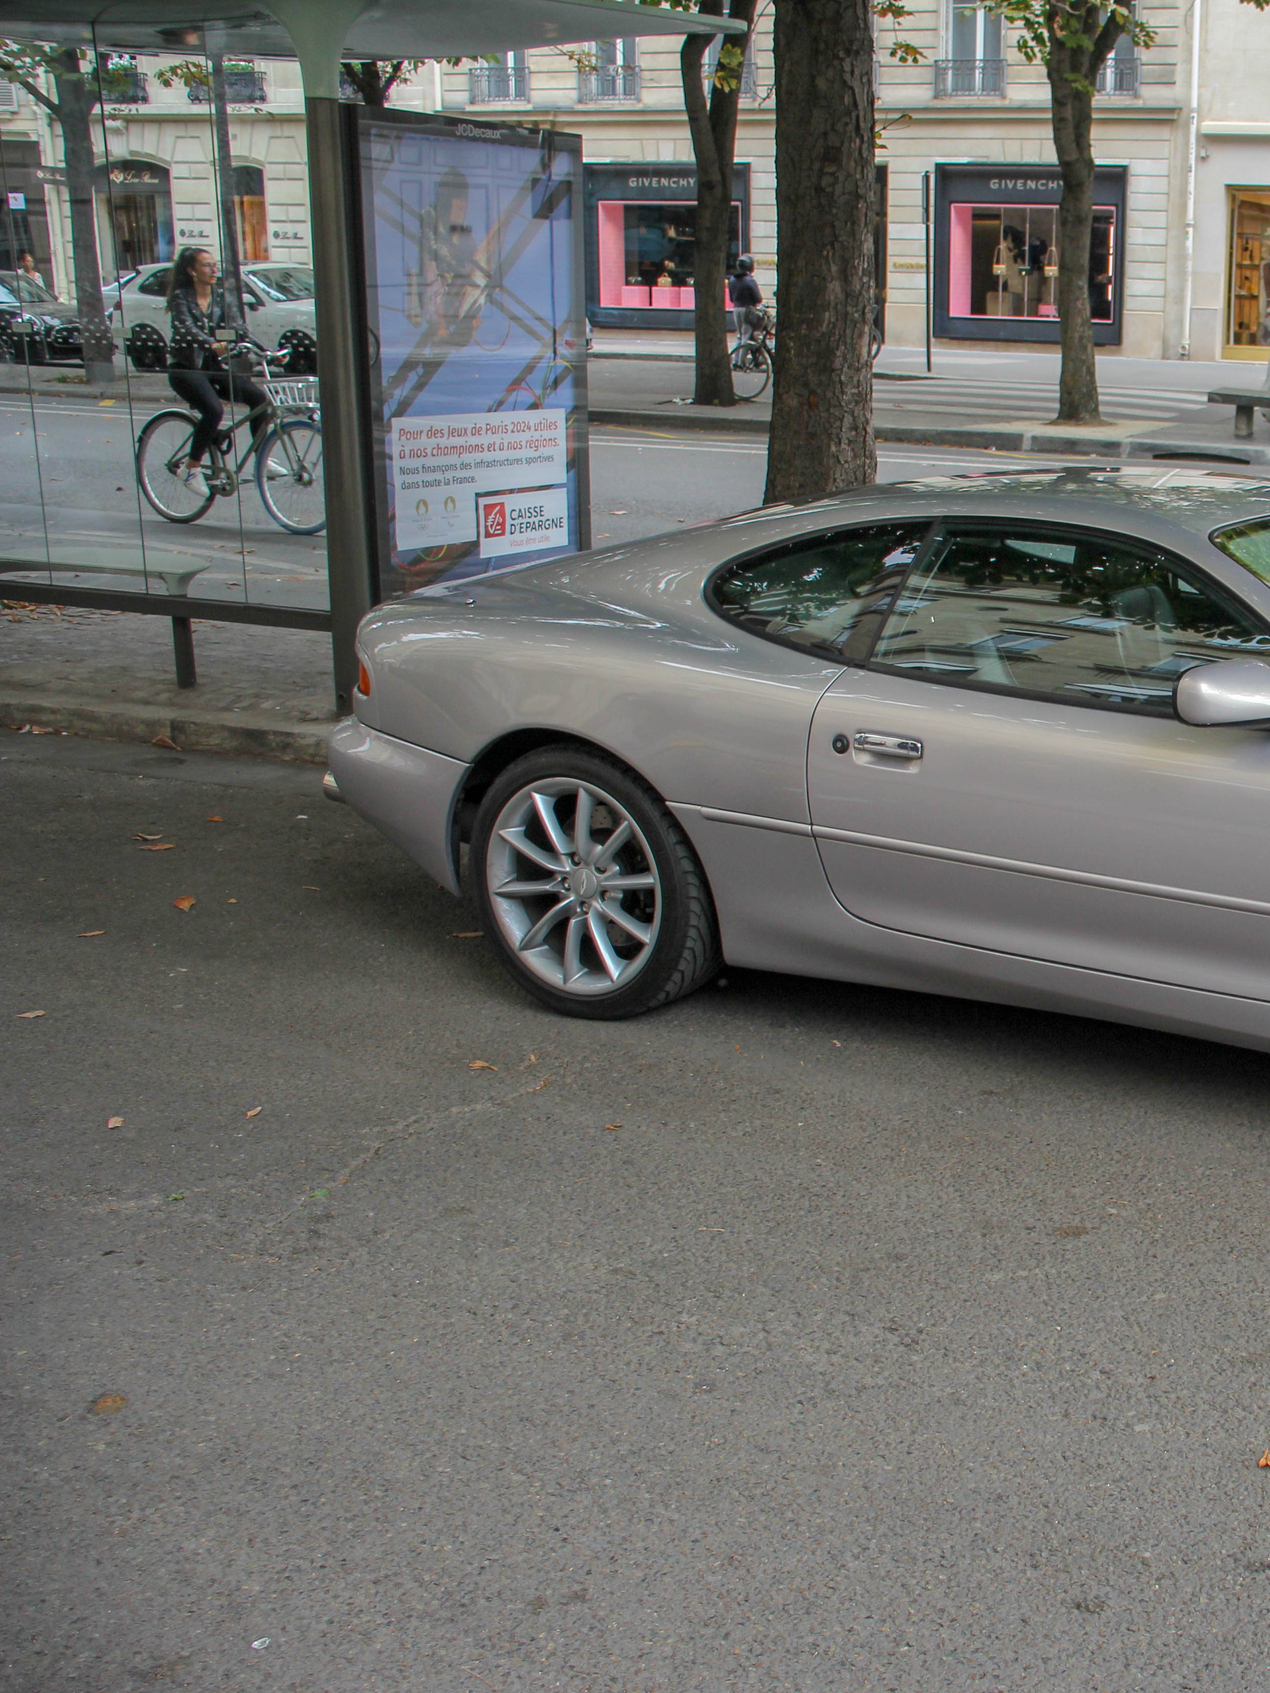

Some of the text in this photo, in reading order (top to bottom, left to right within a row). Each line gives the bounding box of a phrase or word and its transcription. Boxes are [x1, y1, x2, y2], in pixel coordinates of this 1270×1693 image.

[455, 123, 501, 139] JCDecaux
[628, 177, 696, 188] GIVENCHY
[398, 417, 558, 441] Pour des Jeux de Paris 2024 utiles
[399, 434, 559, 459] à nos champions et à nos régions.
[399, 452, 555, 475] Nous finançons des infrastructures sportives
[401, 475, 477, 490] dans toute la France.
[509, 505, 545, 521] CAISSE
[509, 516, 565, 535] D'EPARGNE
[509, 534, 552, 547] Vous être utile.
